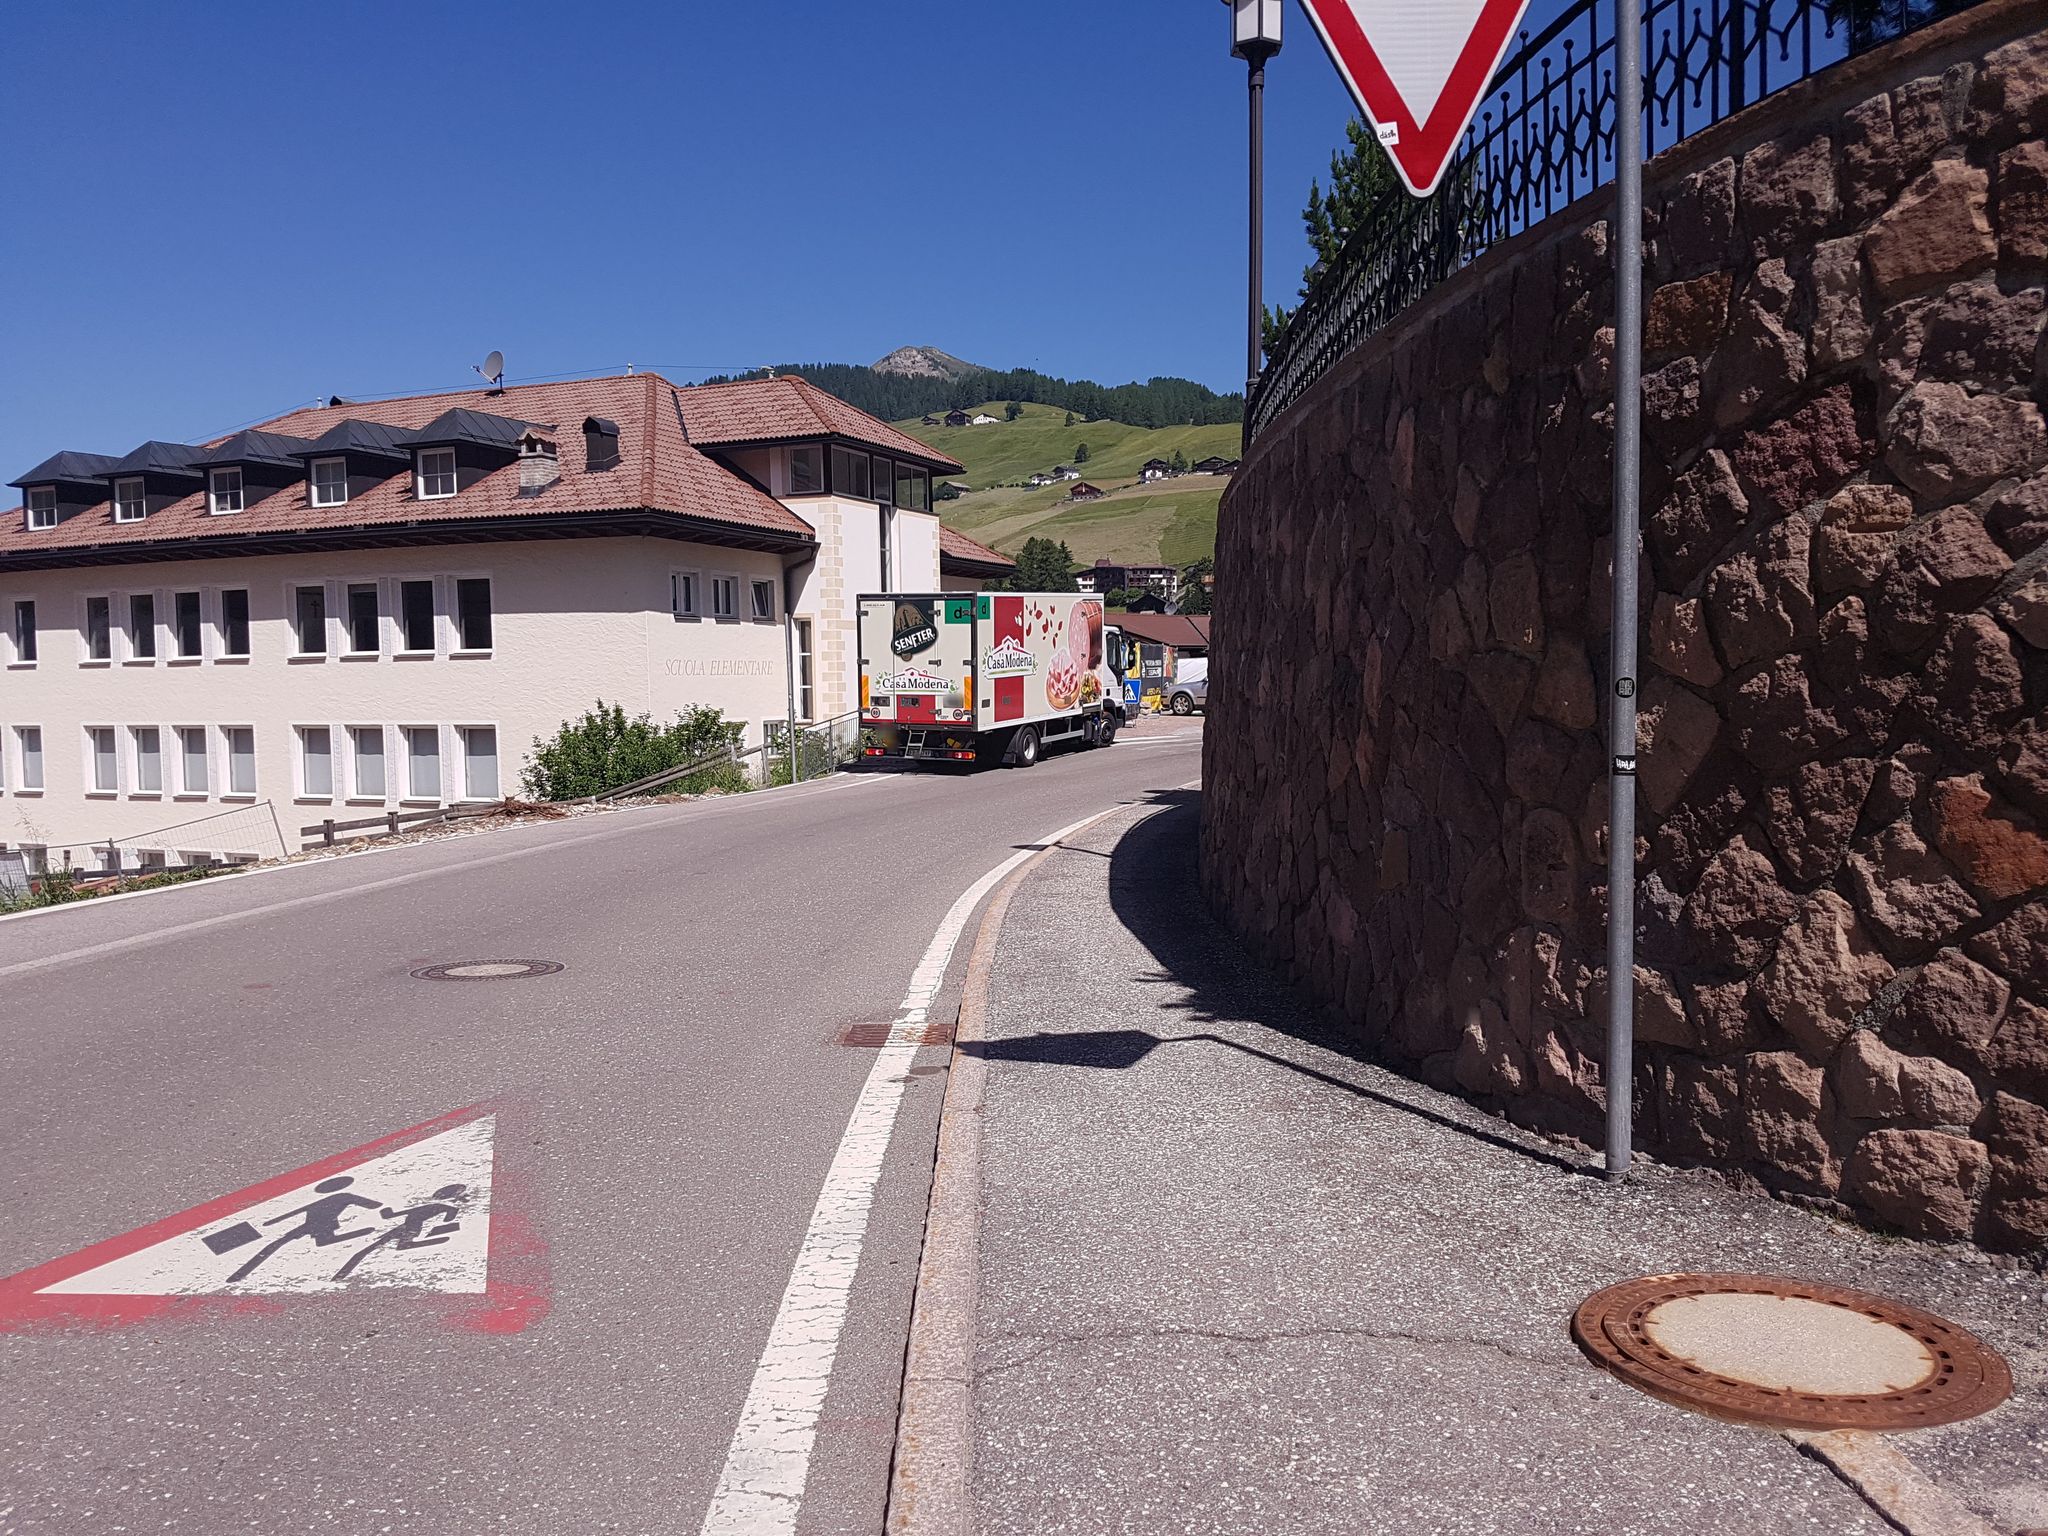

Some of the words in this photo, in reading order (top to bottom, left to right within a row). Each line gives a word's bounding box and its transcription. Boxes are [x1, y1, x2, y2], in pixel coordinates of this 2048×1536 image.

[895, 628, 933, 650] SENFTER
[665, 658, 705, 676] SCUOLA
[710, 660, 773, 676] ELEMENTARE
[987, 654, 1004, 669] Casa
[1005, 653, 1032, 668] Modena
[882, 678, 907, 689] Casa
[908, 678, 949, 689] Modena
